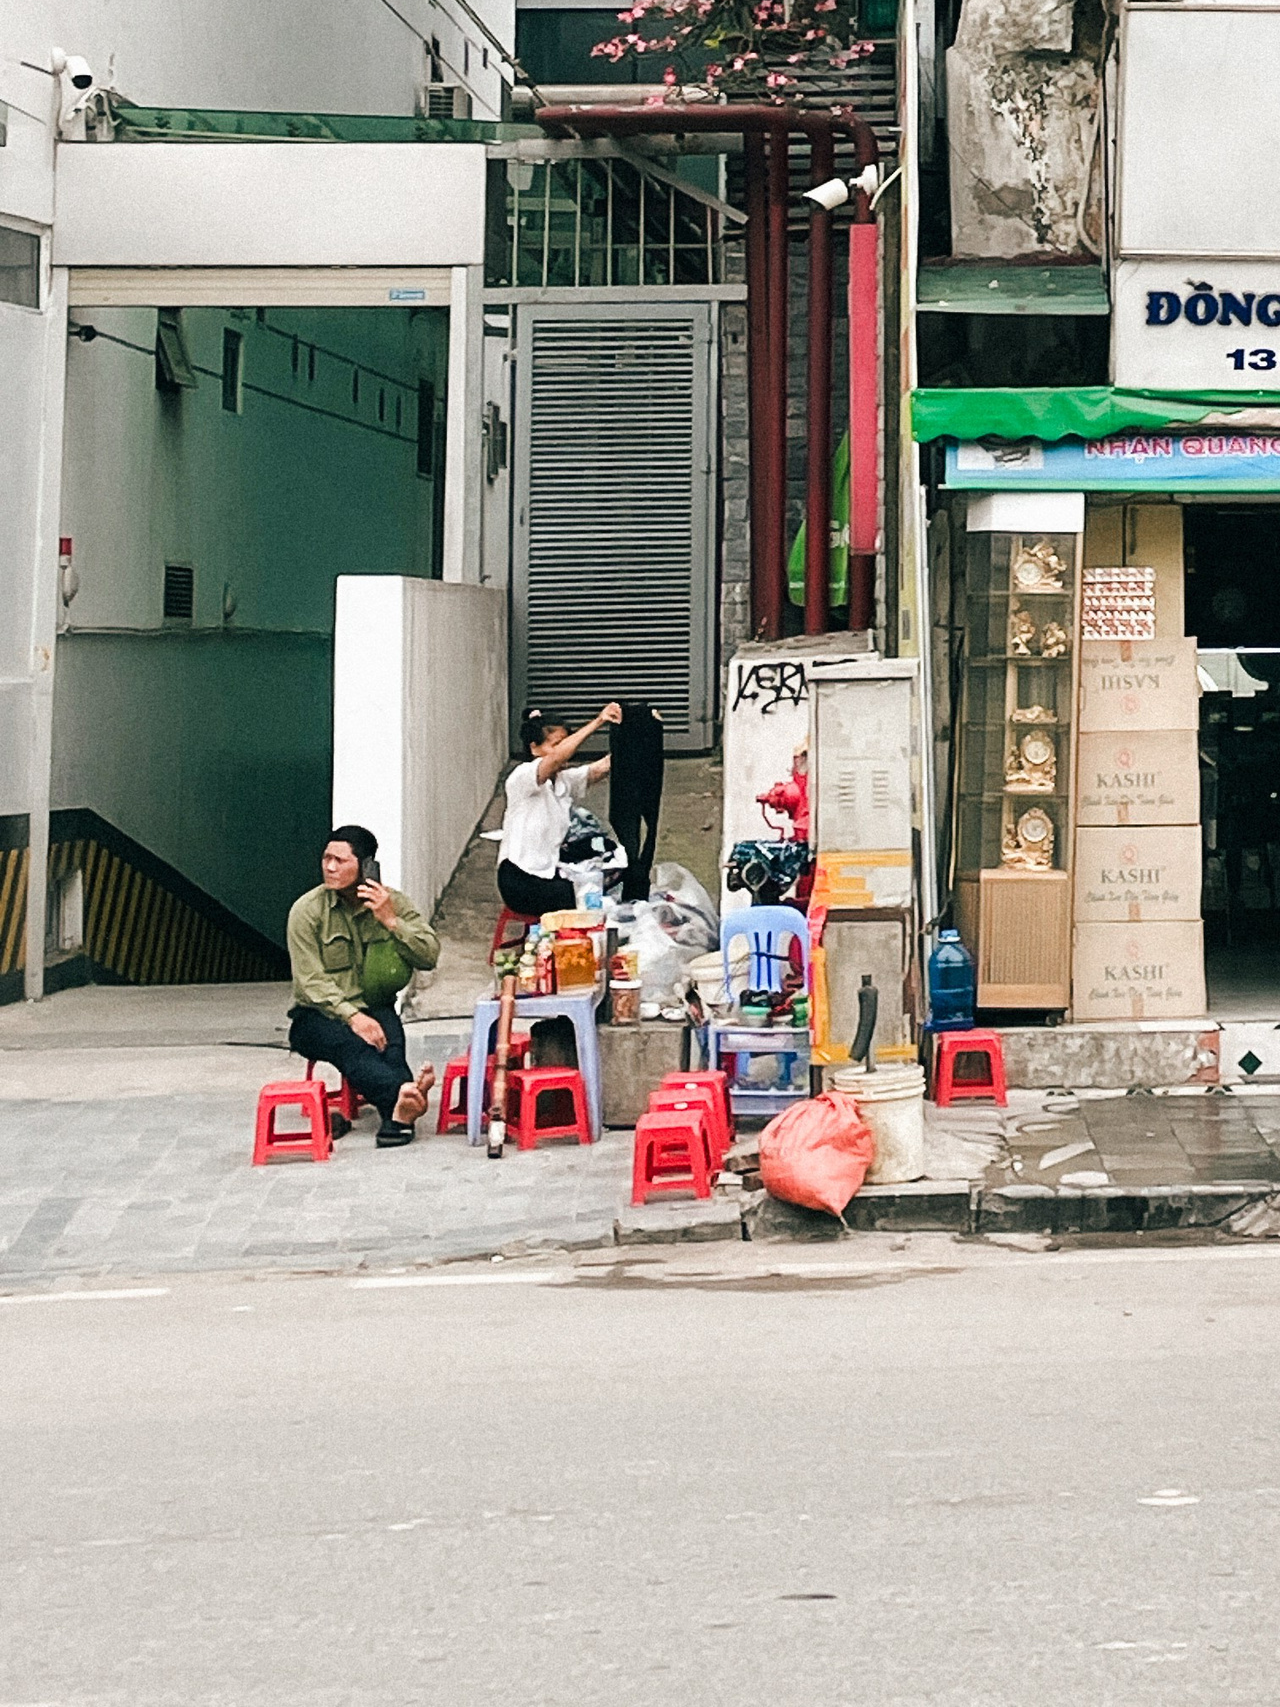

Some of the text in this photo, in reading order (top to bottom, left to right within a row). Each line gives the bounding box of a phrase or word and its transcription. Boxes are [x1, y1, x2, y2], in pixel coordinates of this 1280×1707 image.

[1095, 772, 1157, 789] KASHI
[1100, 867, 1162, 885] KASHI
[1103, 963, 1165, 982] KASHI
